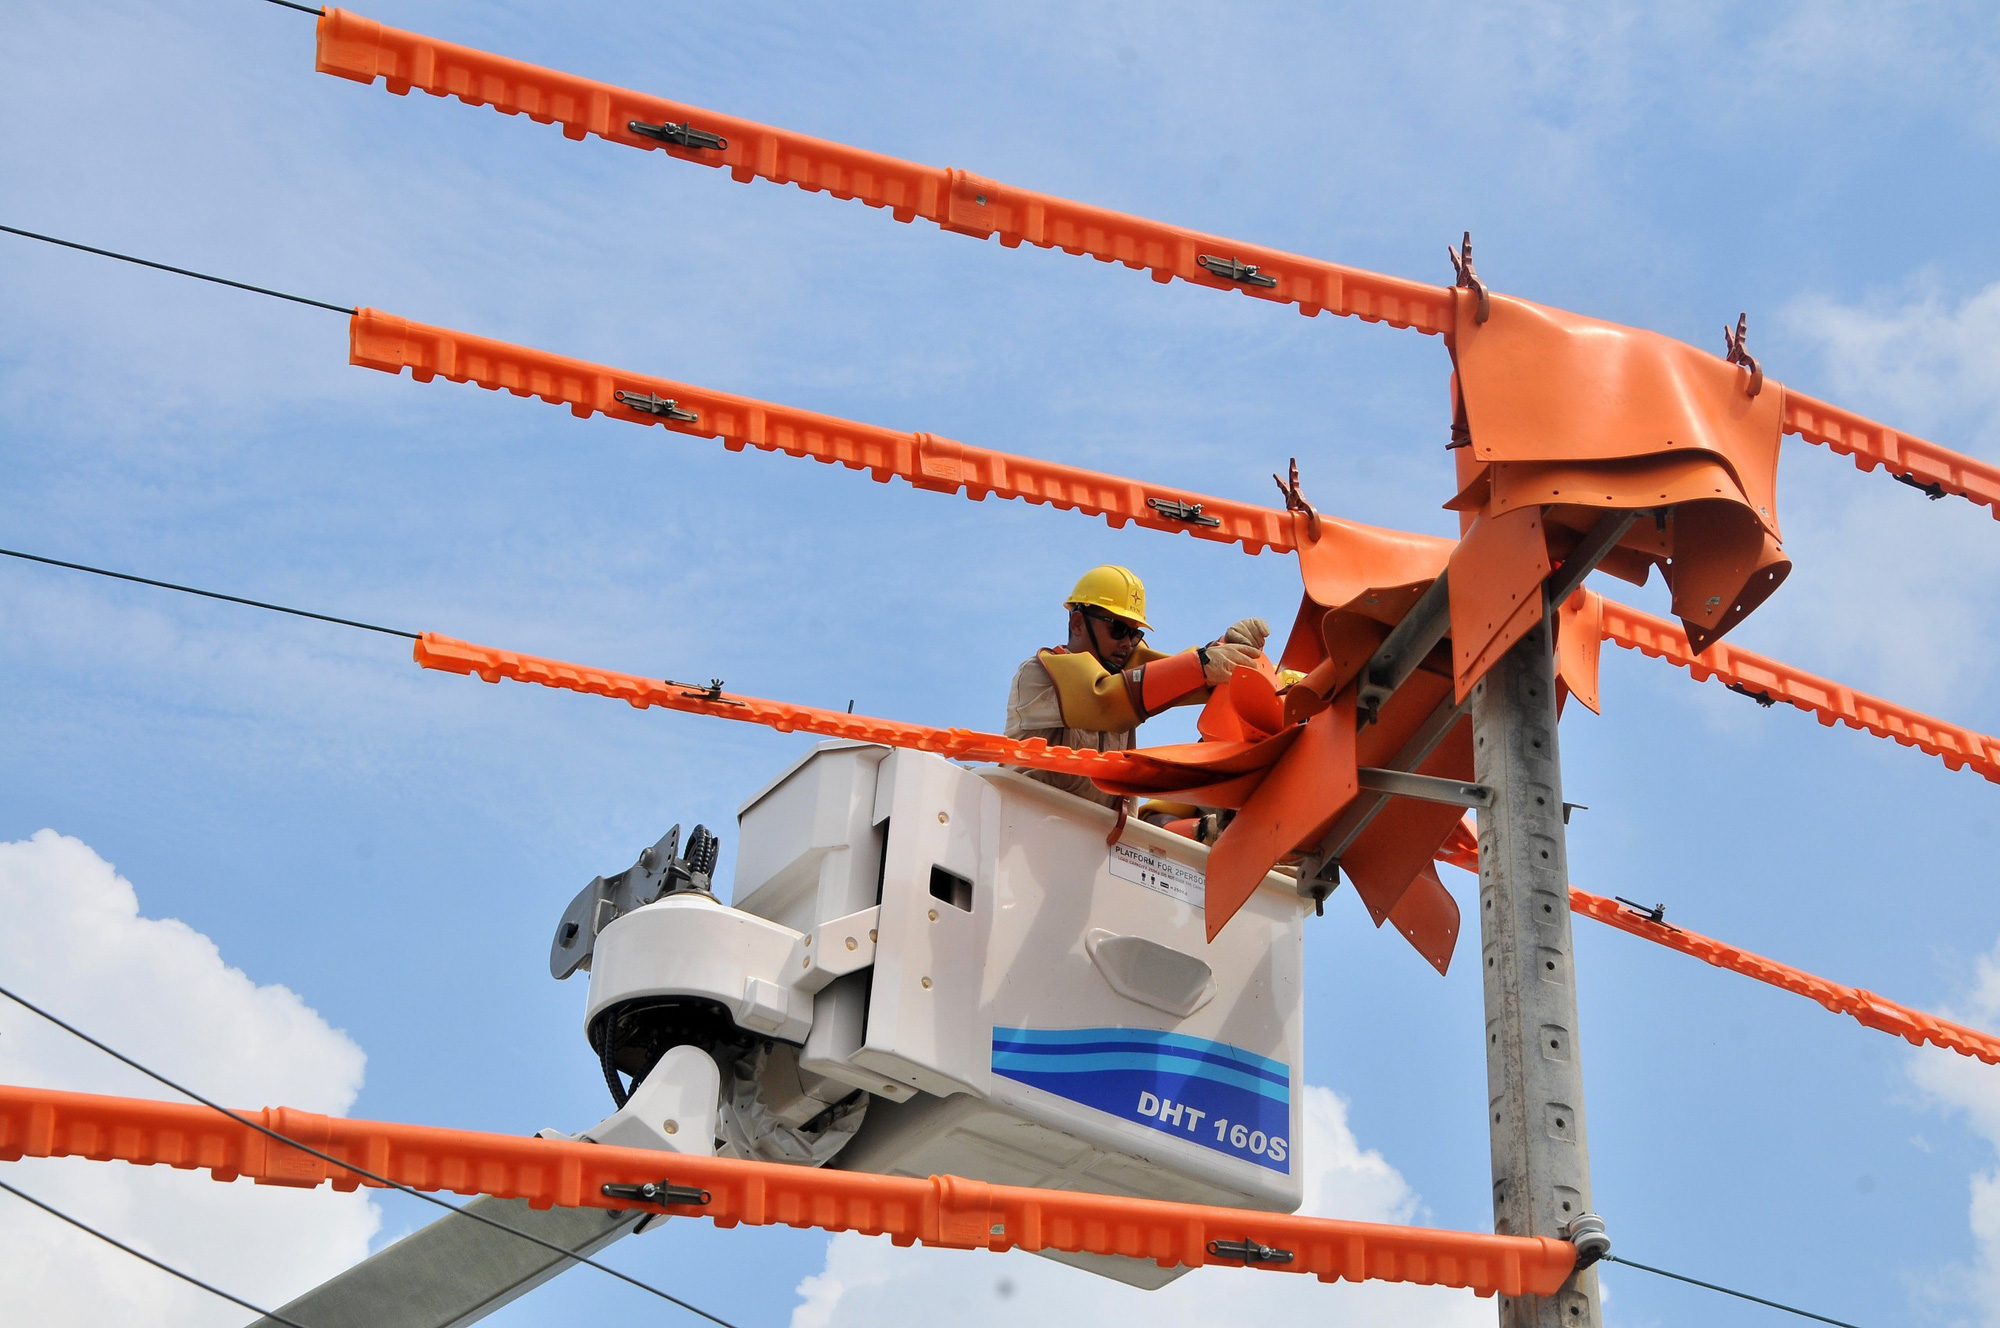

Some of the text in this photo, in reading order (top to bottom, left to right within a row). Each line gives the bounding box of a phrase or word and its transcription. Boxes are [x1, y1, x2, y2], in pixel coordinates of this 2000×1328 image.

[1115, 846, 1155, 866] PLATFORM
[1157, 861, 1173, 874] FOR
[1136, 1090, 1288, 1162] DHT 160S
